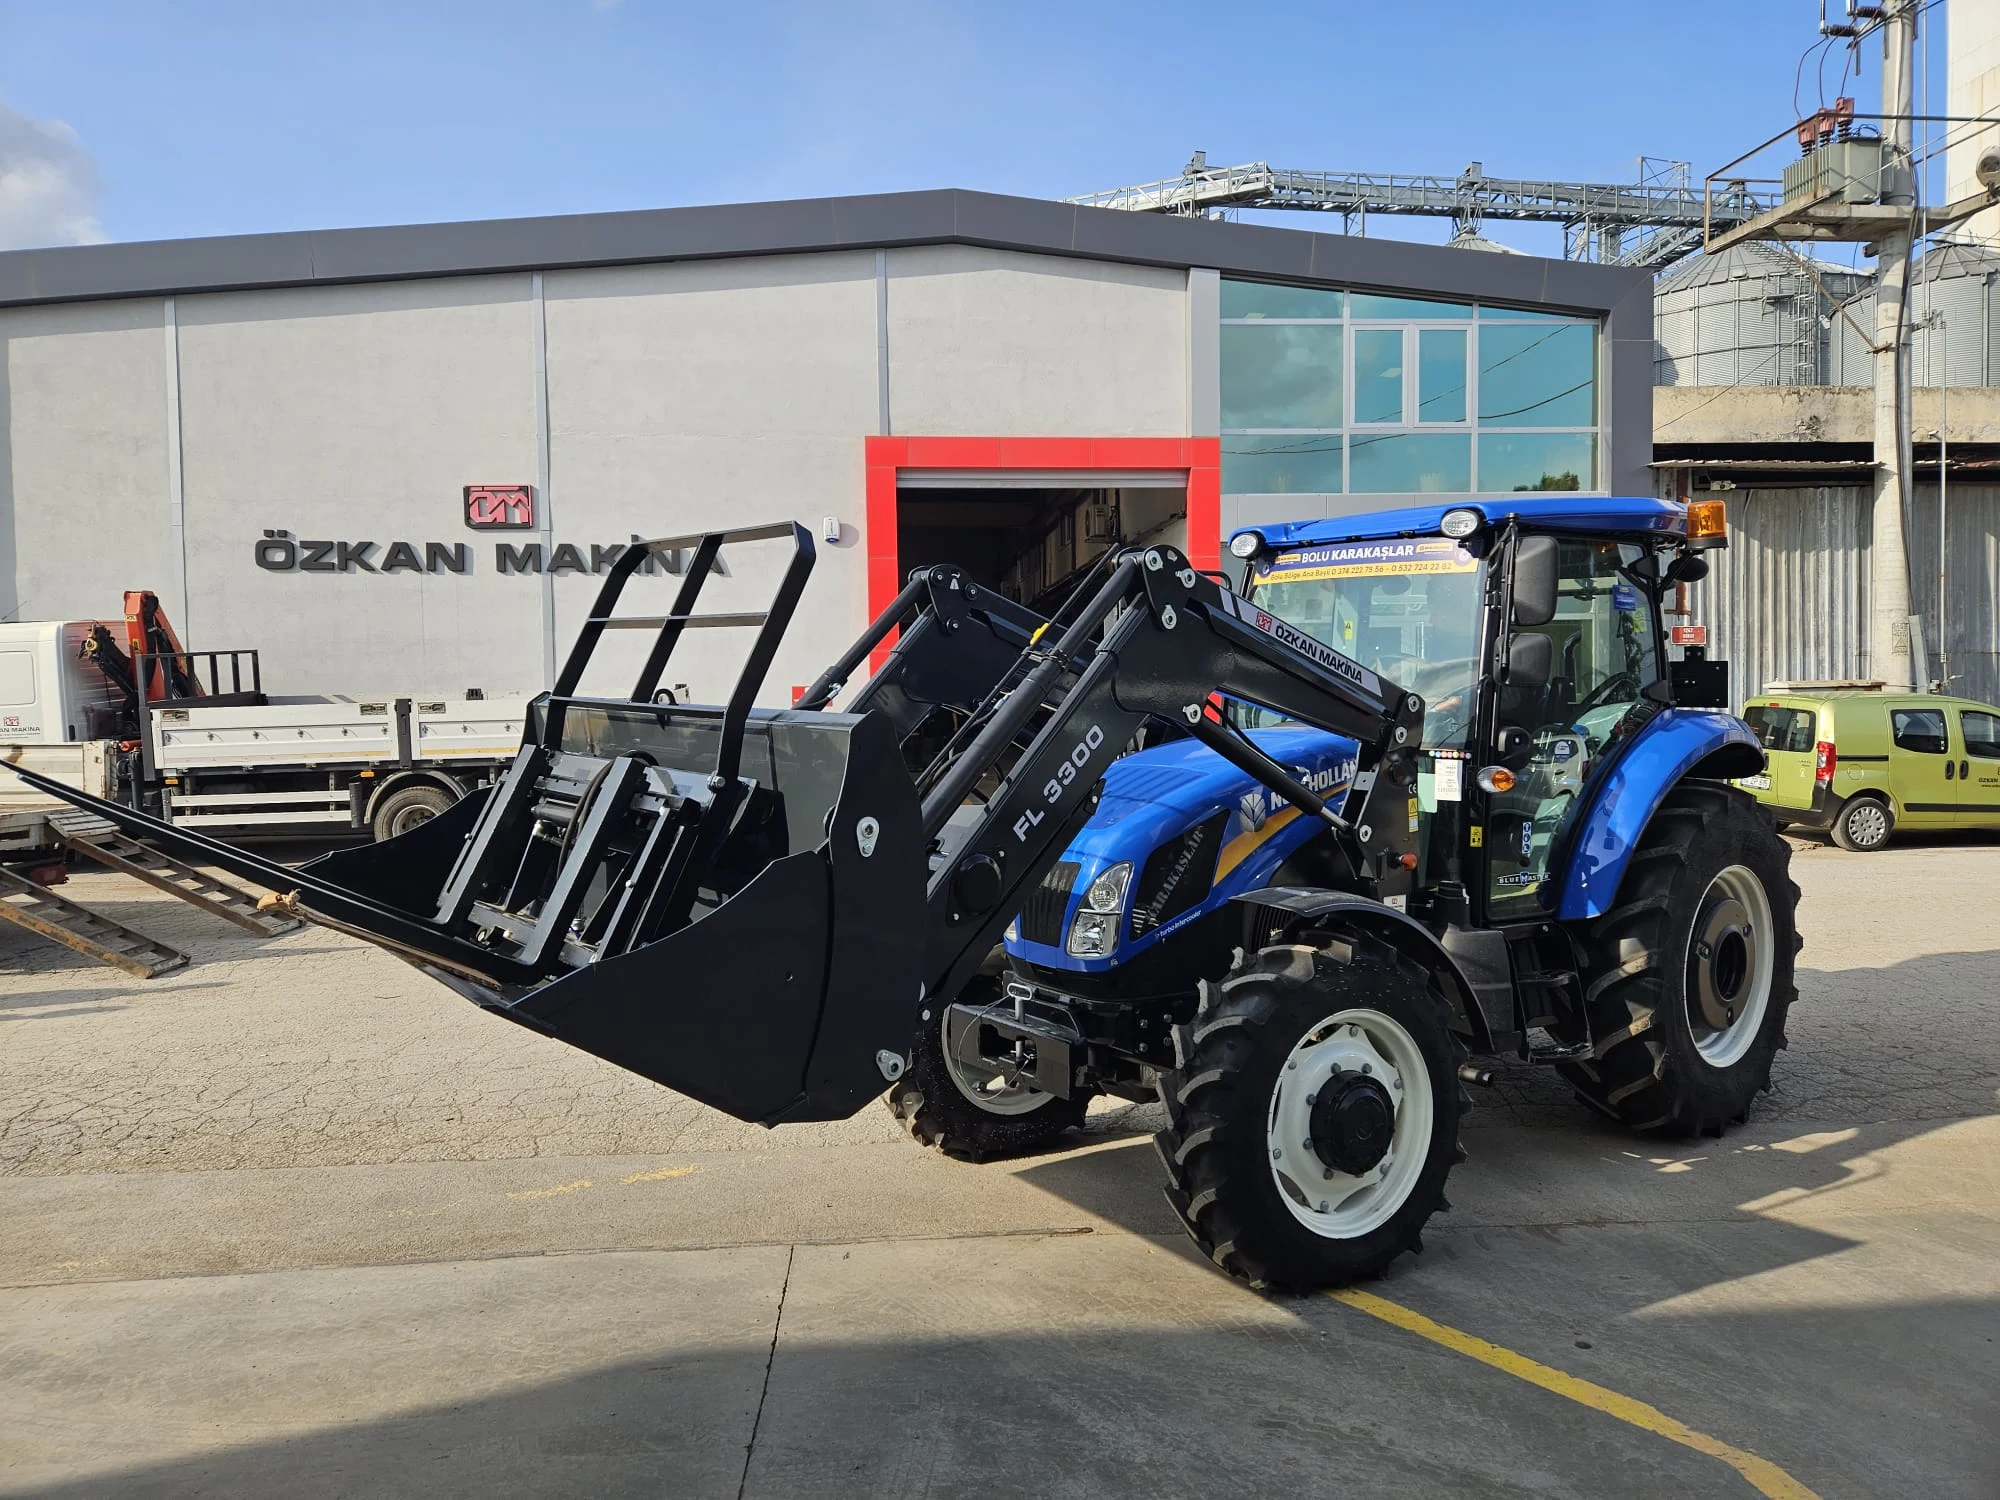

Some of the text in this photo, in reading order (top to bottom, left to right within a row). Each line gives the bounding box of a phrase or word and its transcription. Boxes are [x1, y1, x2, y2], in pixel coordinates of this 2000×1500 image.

[255, 529, 465, 571] ÖZKAN
[1301, 550, 1330, 563] BOLU
[1331, 545, 1414, 561] KARAKAŞLAR
[1337, 567, 1350, 575] 374
[1351, 566, 1364, 574] 222
[1430, 562, 1440, 570] 22
[1275, 623, 1362, 683] ÖZKAN MAKİNA
[1012, 724, 1104, 842] FL 3300
[1307, 759, 1357, 792] HOLLAN
